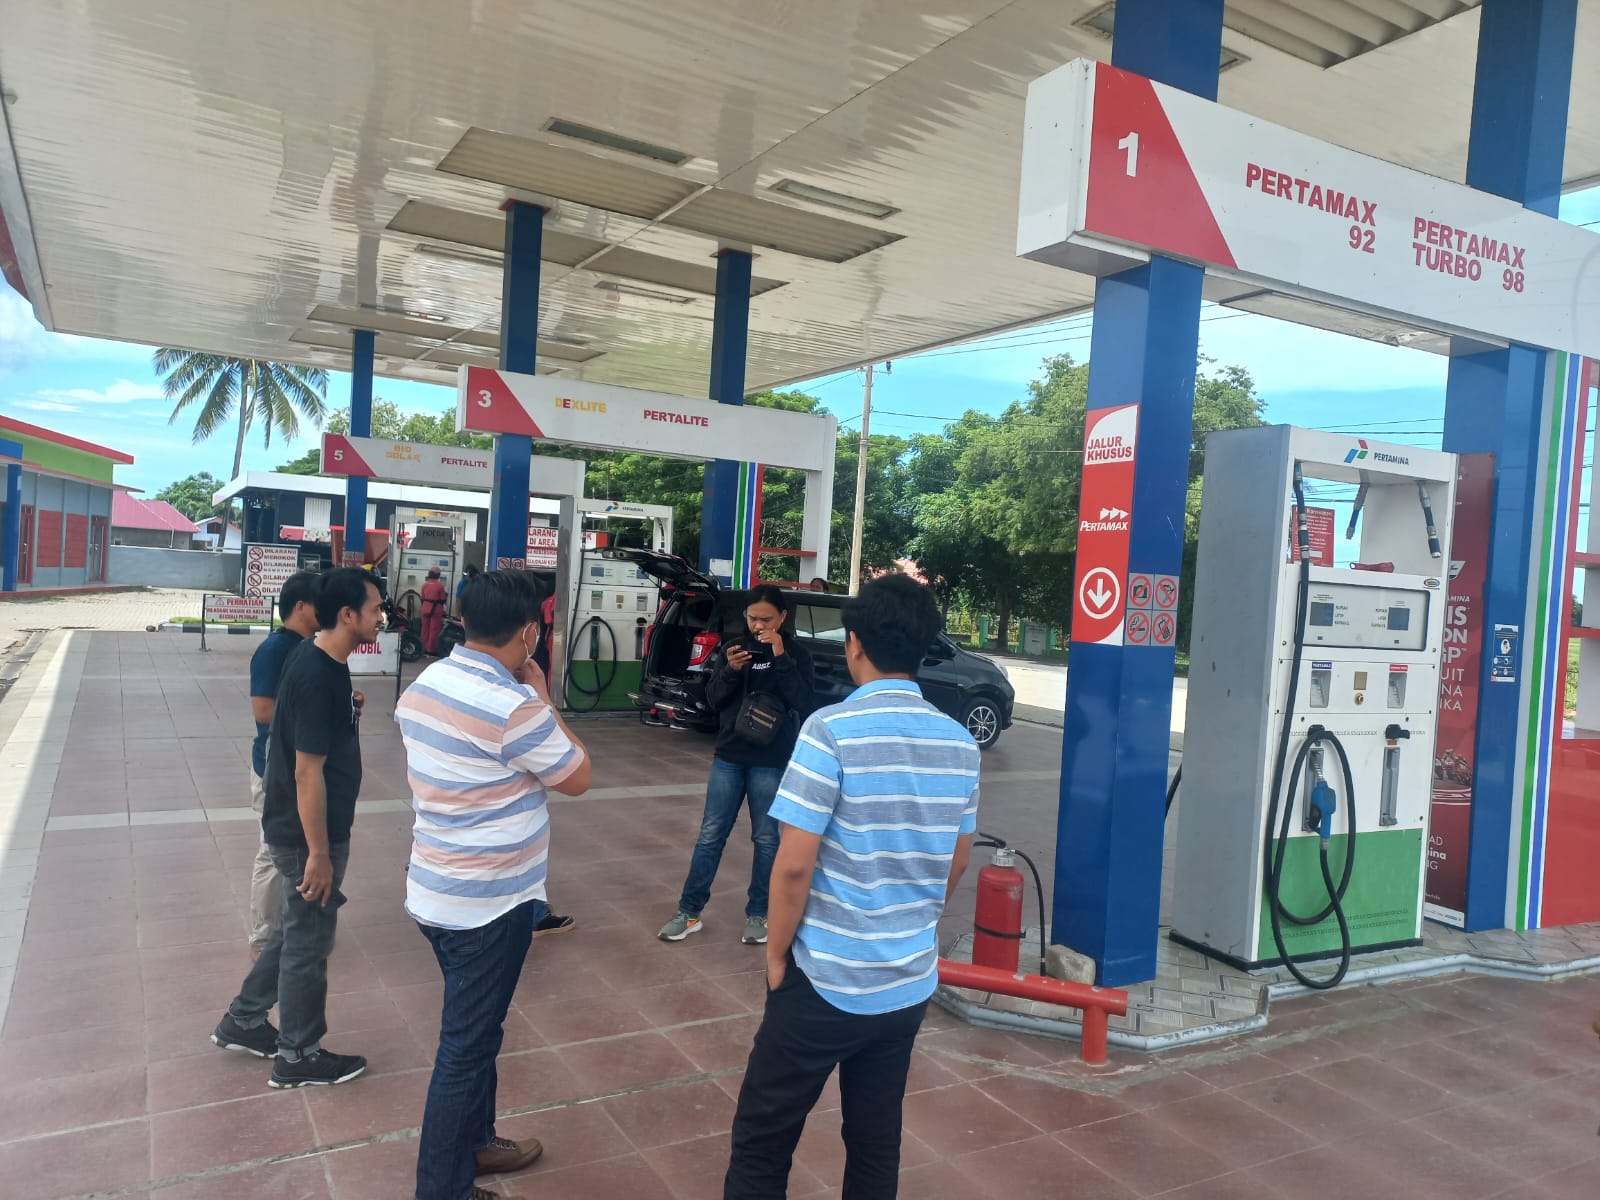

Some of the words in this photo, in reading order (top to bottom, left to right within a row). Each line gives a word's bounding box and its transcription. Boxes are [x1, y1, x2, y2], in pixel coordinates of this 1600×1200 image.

[1118, 131, 1139, 178] 1
[1246, 162, 1377, 226] PERTAMAX
[1349, 225, 1376, 254] 92
[1413, 216, 1525, 270] PERTAMAX
[1412, 243, 1482, 281] TURBO
[1503, 269, 1525, 293] 98
[477, 389, 492, 408] 3
[555, 397, 607, 413] DEXLITE
[643, 409, 709, 427] PERTALITE
[393, 444, 413, 453] BIO
[1088, 436, 1122, 450] JALUR
[333, 449, 344, 461] 5
[385, 451, 422, 462] SOLAR
[1087, 446, 1132, 461] KHUSUS
[1374, 452, 1409, 465] PERTAMINA
[441, 456, 488, 469] PERTALITE
[528, 528, 557, 538] LARANG
[1080, 520, 1129, 532] PERTAMAX
[538, 538, 556, 546] AREA
